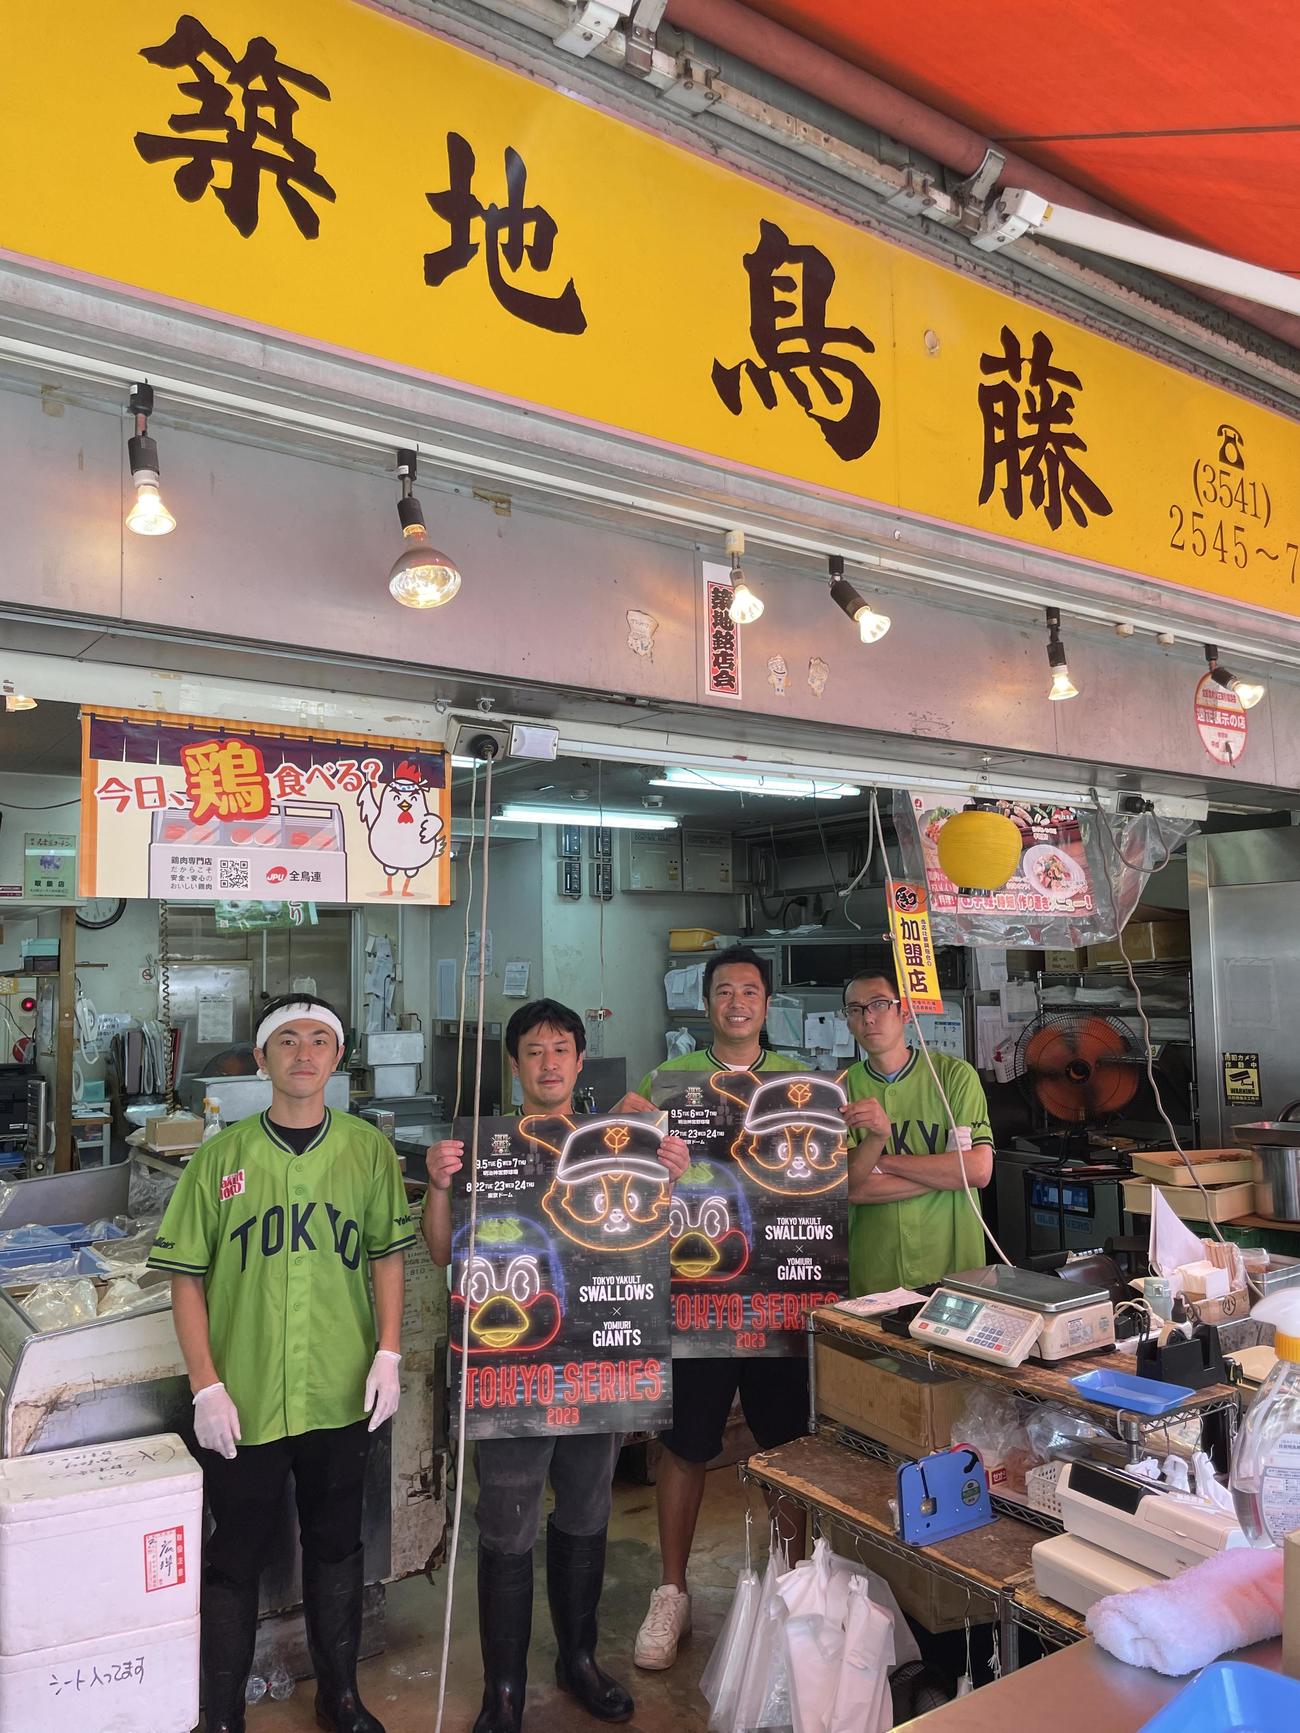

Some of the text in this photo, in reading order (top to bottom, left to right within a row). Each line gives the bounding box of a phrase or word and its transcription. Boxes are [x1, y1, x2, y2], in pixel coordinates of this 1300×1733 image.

[134, 14, 1113, 530] 築地鳥藤
[1193, 459, 1271, 528] (3541)
[171, 857, 212, 865] 鶏肉専門店
[171, 866, 212, 874] だからこそ
[289, 870, 322, 882] 全鳥連
[900, 918, 929, 993] 加盟店
[776, 1217, 821, 1225] TOKYO YAKULT
[230, 1202, 360, 1273] TOKYO
[765, 1225, 833, 1240] SWALLOWS
[786, 1257, 812, 1266] YOMIURI
[592, 1275, 642, 1285] TOKYO YAKULT
[777, 1265, 822, 1280] GIANTS
[579, 1283, 654, 1302] SWALLOWS
[672, 1293, 743, 1330] OKYO
[603, 1321, 631, 1330] YOMIURI
[592, 1329, 642, 1347] GIANTS
[736, 1332, 766, 1348] 2023
[466, 1357, 663, 1408] TOKYO SERIES
[547, 1408, 580, 1424] 2023
